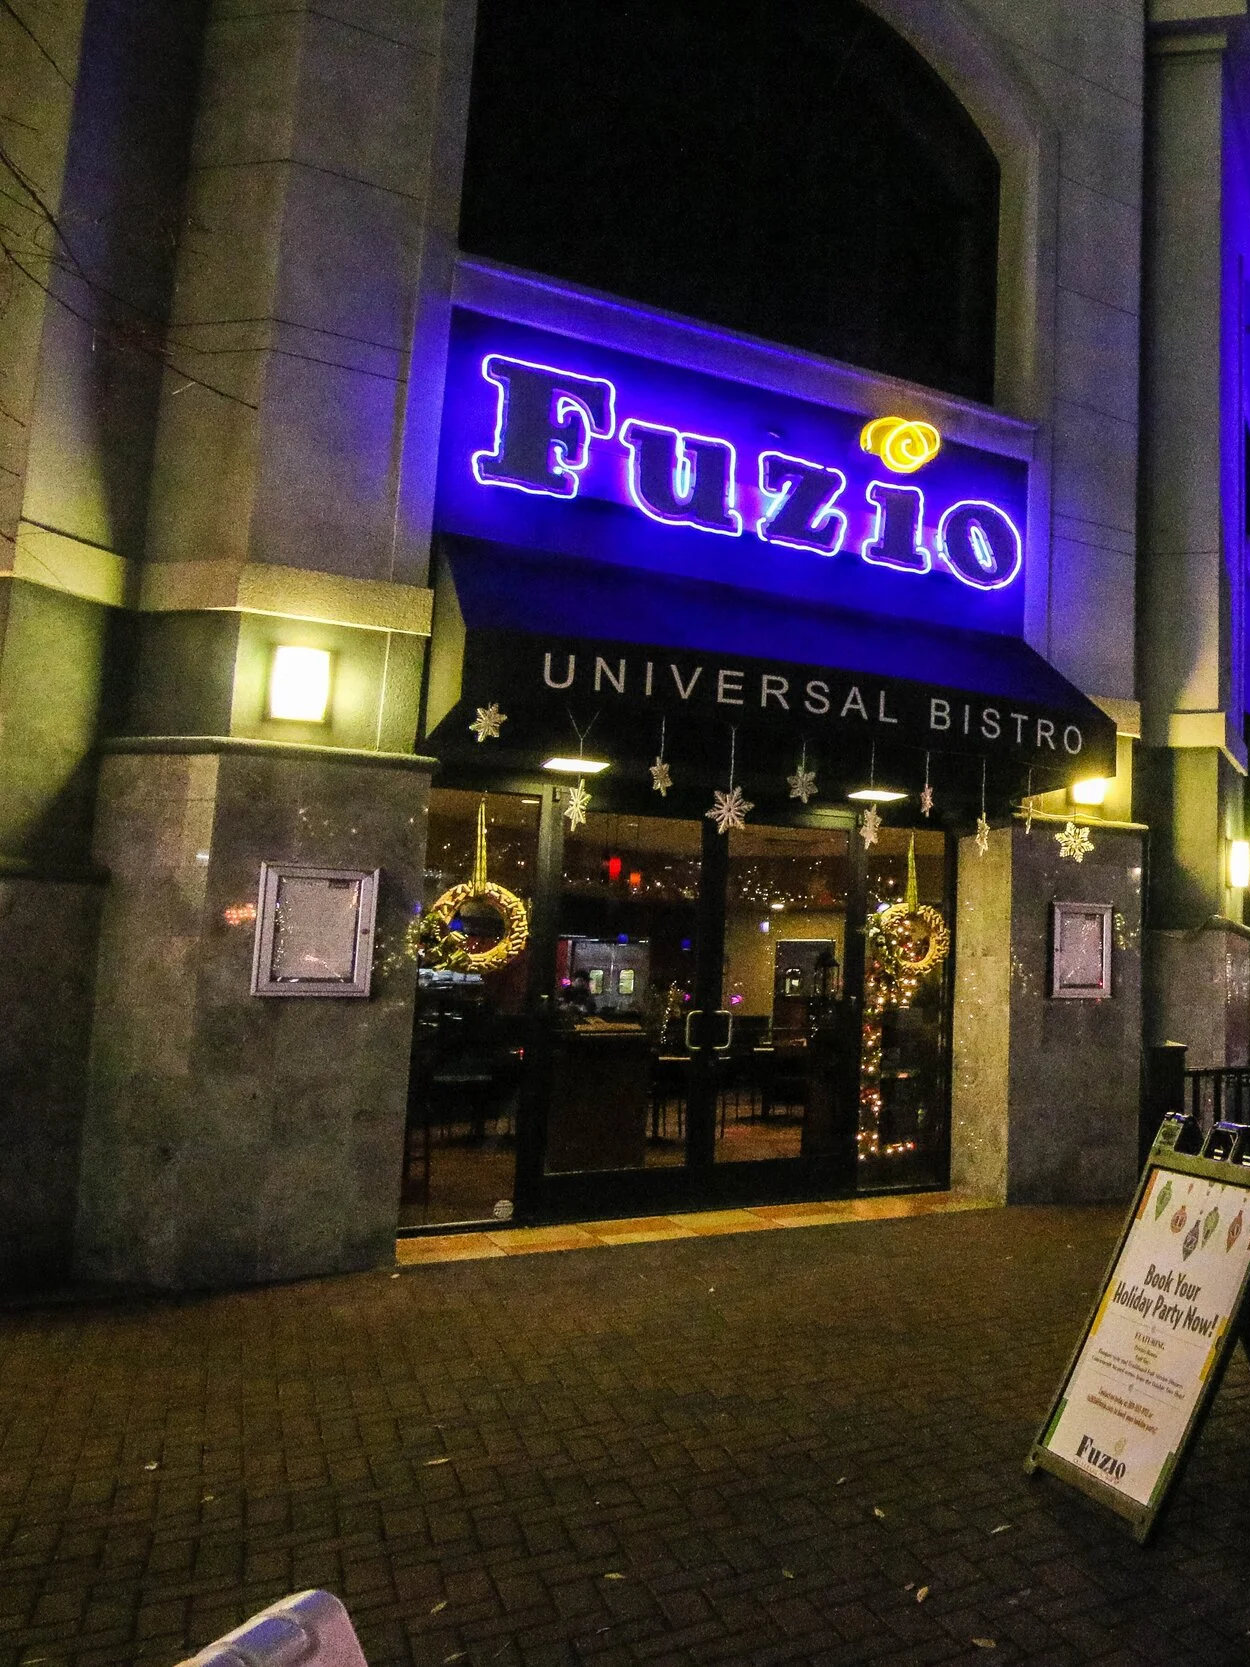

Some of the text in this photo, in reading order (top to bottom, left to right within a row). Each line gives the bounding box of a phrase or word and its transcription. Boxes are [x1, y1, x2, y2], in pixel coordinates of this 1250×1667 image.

[471, 353, 1022, 590] Fuzio
[543, 652, 1083, 755] UNIVERSAL BISTRO
[1113, 1281, 1219, 1338] Holiday Party Now!
[1143, 1263, 1201, 1302] Book Your
[1076, 1434, 1126, 1478] Fuzio
